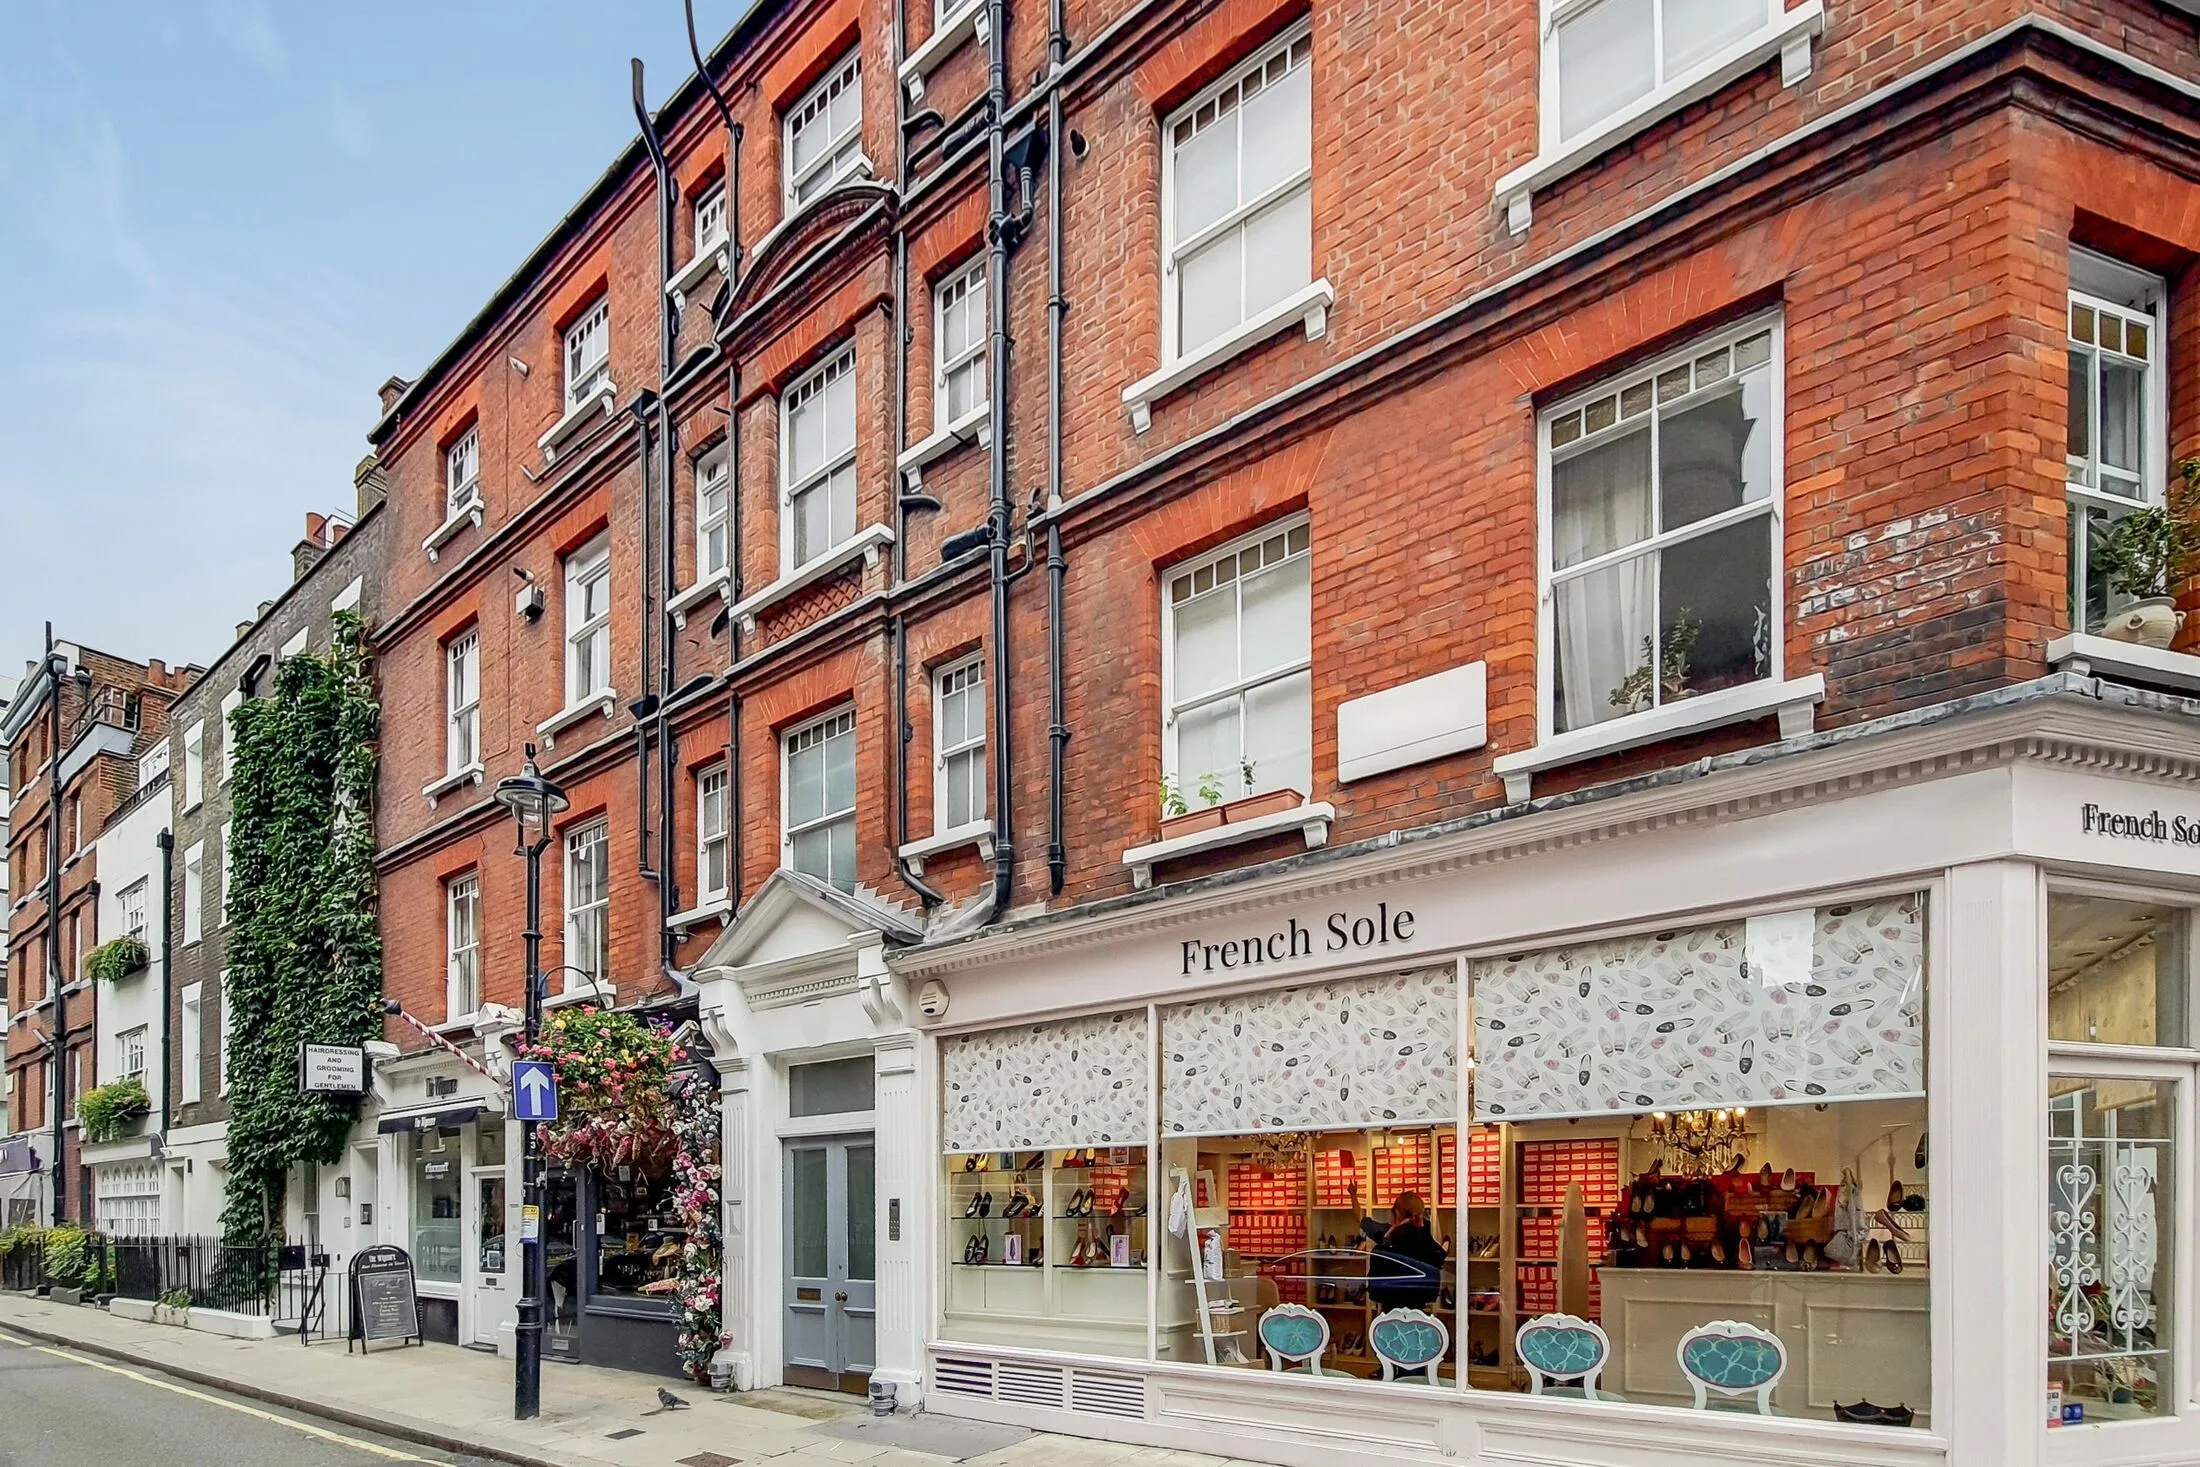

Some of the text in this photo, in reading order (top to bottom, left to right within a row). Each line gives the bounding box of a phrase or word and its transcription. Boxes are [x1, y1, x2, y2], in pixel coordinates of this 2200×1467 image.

[2081, 803, 2168, 843] French
[1180, 902, 1415, 976] French Sole
[308, 1047, 360, 1056] HAIRDRESSING
[316, 1065, 354, 1073] GROOMING
[314, 1082, 356, 1090] GENTLEMEN
[529, 1132, 536, 1140] S
